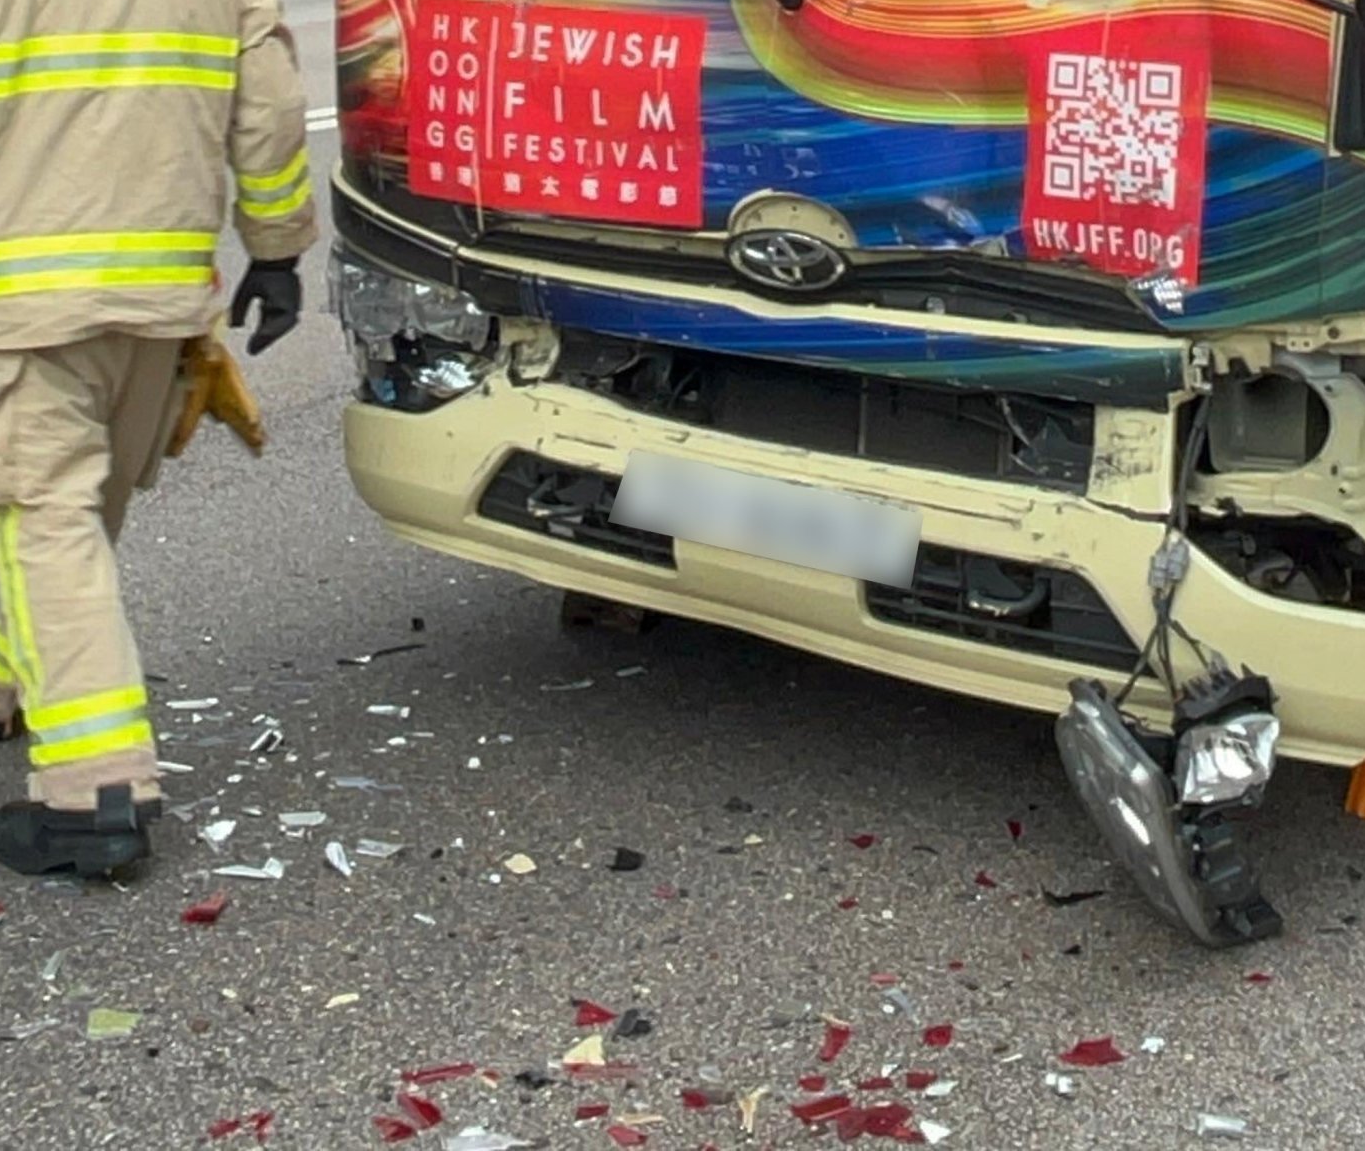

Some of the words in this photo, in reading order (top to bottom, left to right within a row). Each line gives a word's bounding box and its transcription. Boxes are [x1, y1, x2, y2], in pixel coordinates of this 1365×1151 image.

[507, 21, 680, 70] JEWISH
[503, 81, 676, 132] FILM
[503, 133, 679, 172] FESTIVAL
